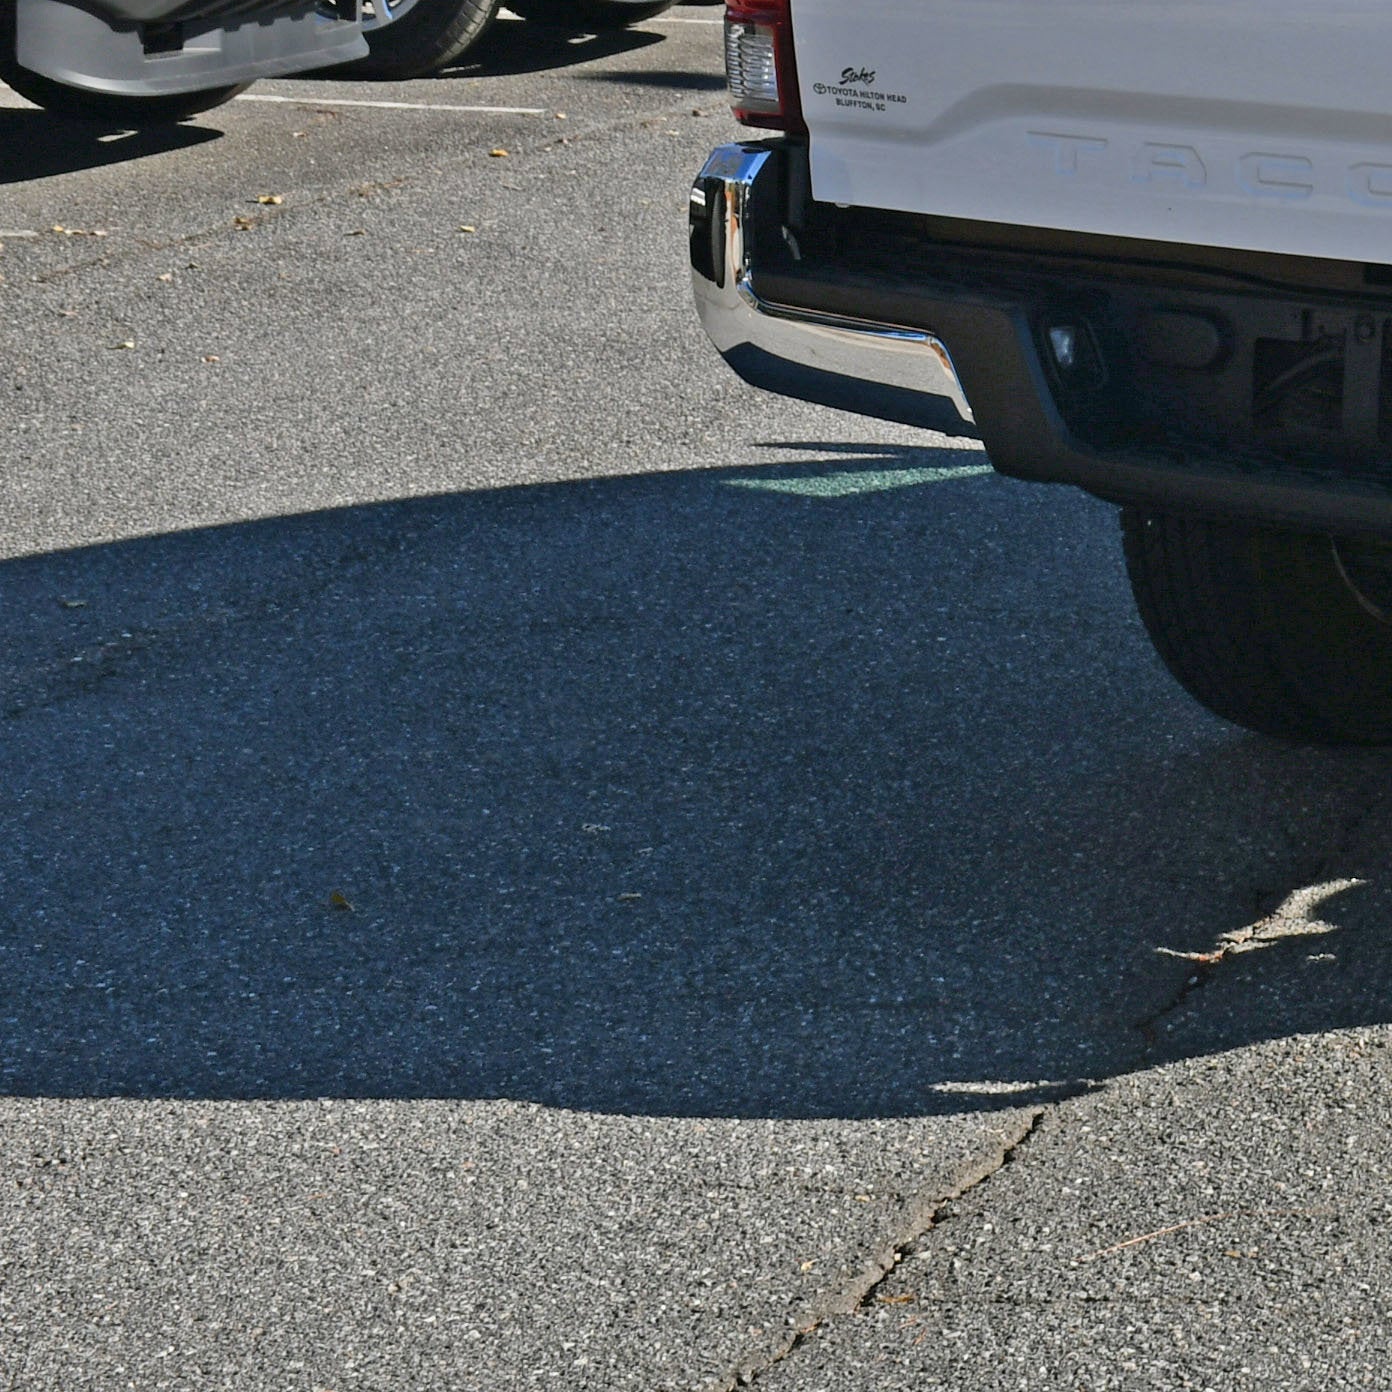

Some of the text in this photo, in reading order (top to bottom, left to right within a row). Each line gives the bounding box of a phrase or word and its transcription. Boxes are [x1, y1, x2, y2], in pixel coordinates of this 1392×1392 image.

[839, 67, 876, 85] Stokes
[827, 86, 907, 104] TOYOTA HILTON HEAD
[875, 103, 886, 111] SC
